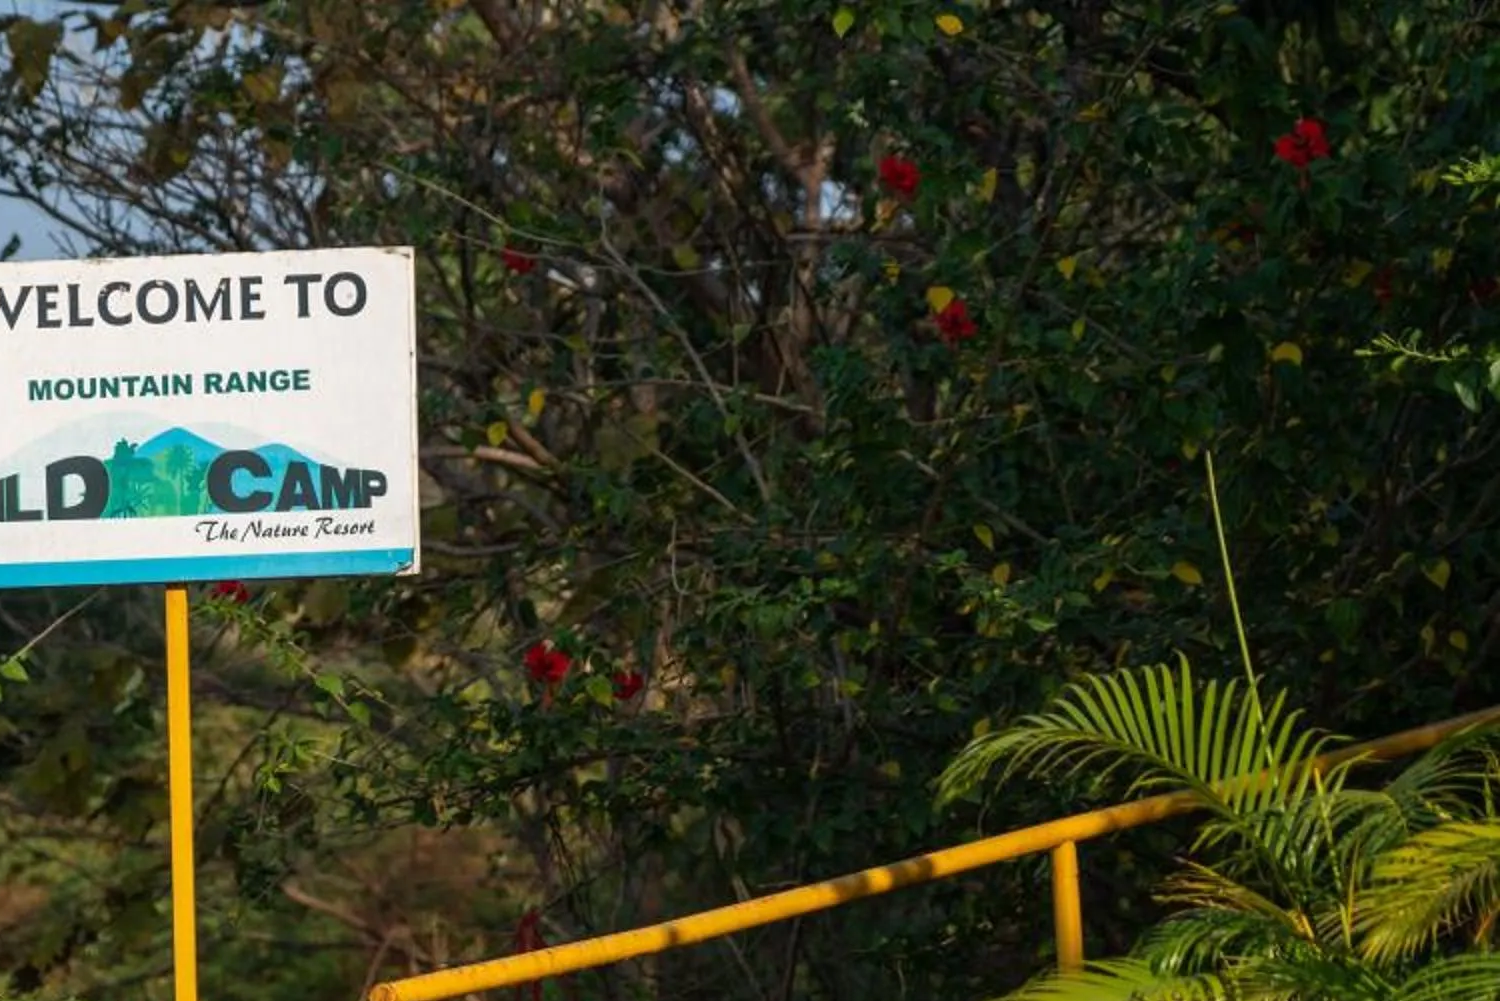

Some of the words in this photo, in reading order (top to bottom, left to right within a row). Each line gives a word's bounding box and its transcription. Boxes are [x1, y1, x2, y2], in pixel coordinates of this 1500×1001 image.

[284, 271, 368, 318] TO
[28, 373, 194, 401] MOUNTAIN
[203, 369, 311, 394] RANGE
[206, 449, 388, 513] CAMP
[195, 520, 238, 543] The
[240, 519, 310, 543] Nature
[314, 517, 376, 539] Resort
